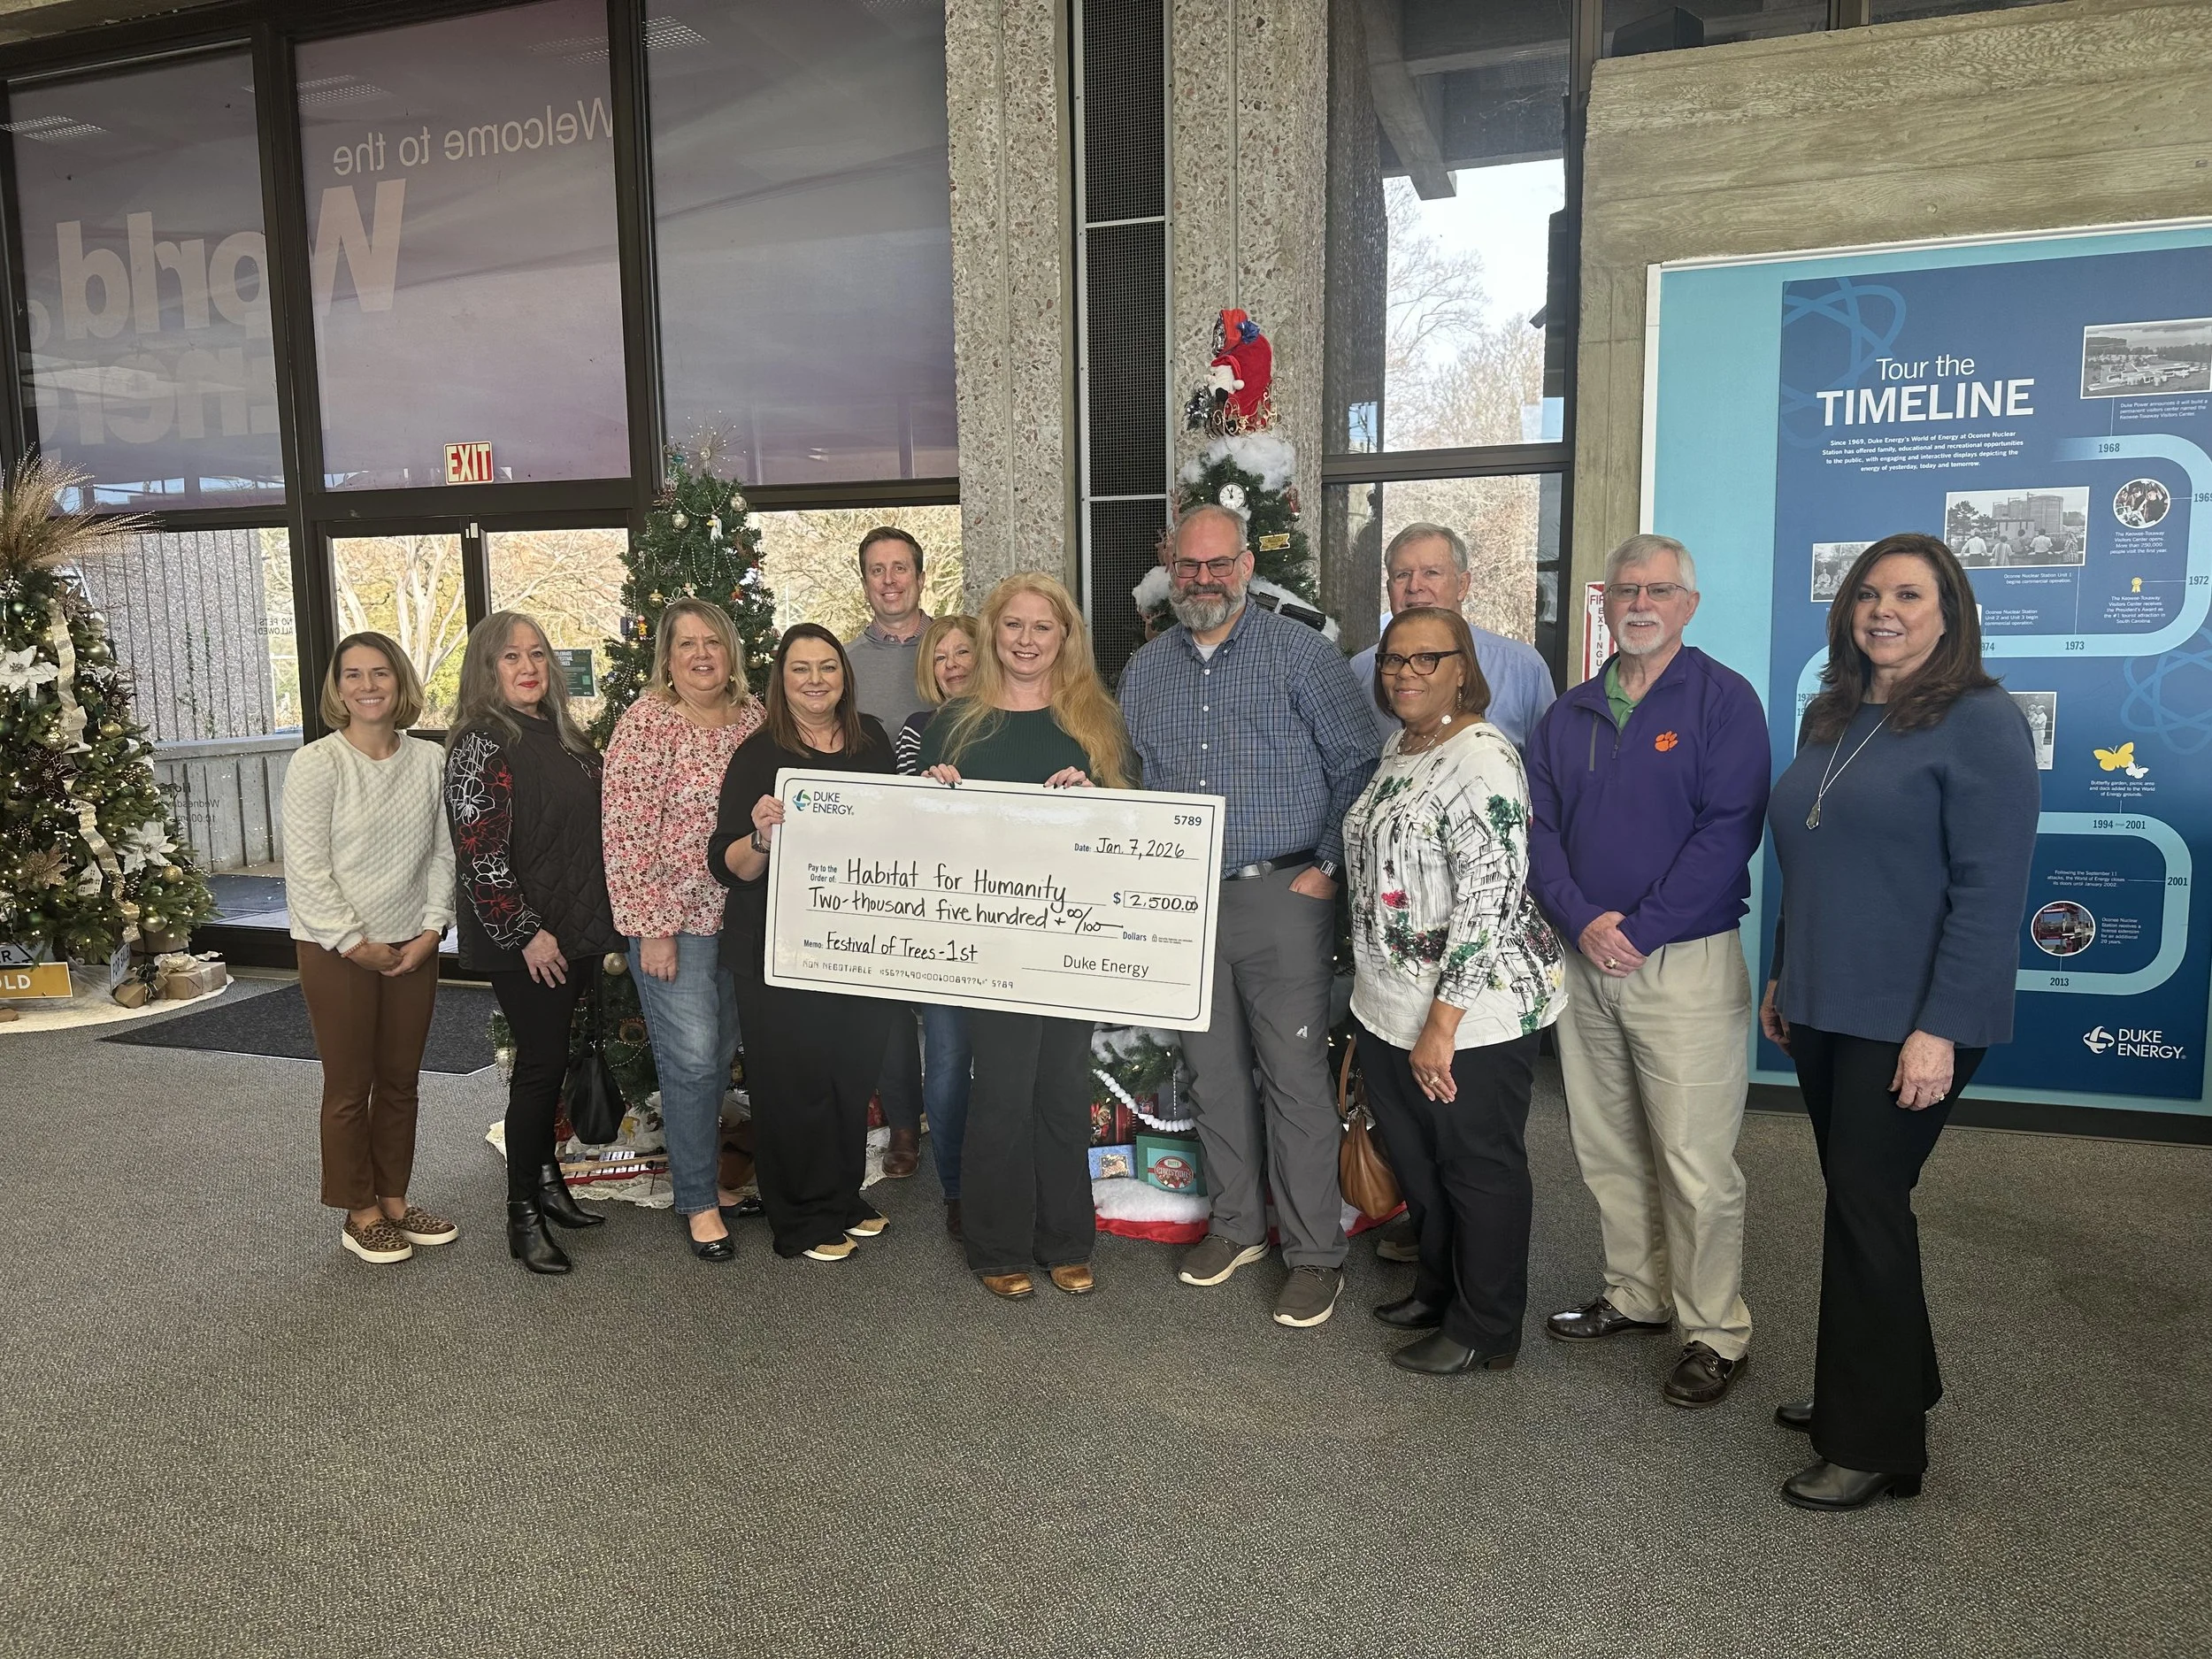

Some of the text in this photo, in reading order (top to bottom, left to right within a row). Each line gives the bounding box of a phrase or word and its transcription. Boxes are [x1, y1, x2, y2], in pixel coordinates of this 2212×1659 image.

[1875, 353, 1975, 380] Tour the
[1816, 378, 2035, 426] TIMELINE
[2098, 442, 2120, 453] 1968
[446, 443, 490, 482] EXIT
[2188, 576, 2209, 585] 1972
[1980, 641, 2085, 651] 974 1973
[813, 791, 841, 803] DUKE
[1173, 815, 1202, 826] 5789
[2093, 819, 2114, 829] 1994
[2125, 820, 2146, 830] 2001
[1074, 843, 1092, 852] Date:
[1096, 837, 1124, 855] Jan.
[808, 864, 819, 872] Pay
[827, 864, 838, 873] the
[810, 873, 837, 883] Order of:
[2168, 877, 2188, 887] 2001
[848, 857, 1067, 914] Habitat for Humanity
[935, 898, 972, 921] five
[976, 902, 1048, 929] hundred
[1123, 931, 1148, 941] Dollars
[803, 939, 824, 949] Memo:
[826, 931, 876, 954] Festival
[880, 935, 897, 956] of
[1064, 955, 1149, 979] Duke Energy
[803, 960, 819, 969] NON
[822, 962, 872, 975] NEGOTIABLE
[992, 979, 1013, 989] 5789
[2050, 977, 2070, 987] 2013
[2118, 1029, 2162, 1043] DUKE
